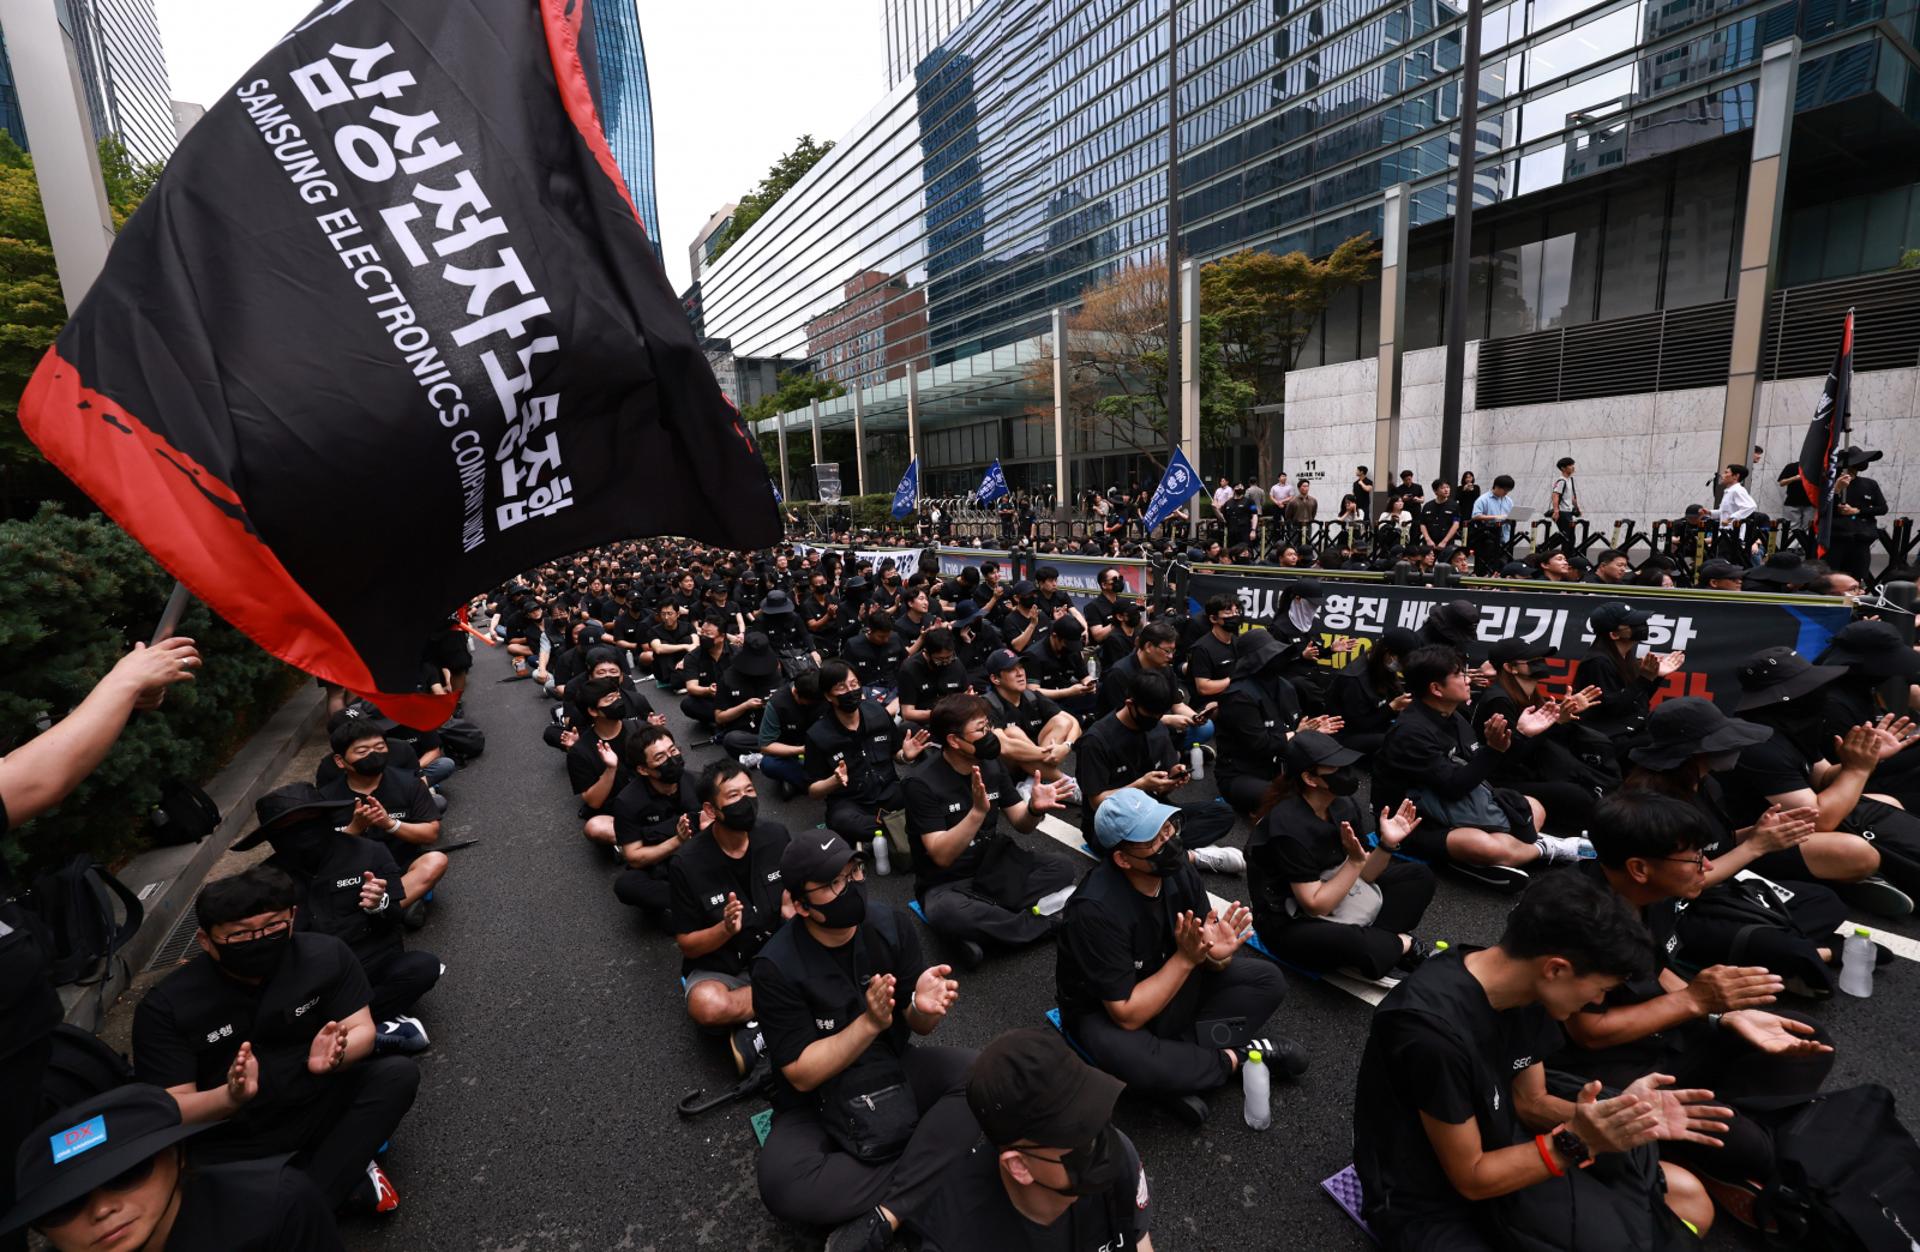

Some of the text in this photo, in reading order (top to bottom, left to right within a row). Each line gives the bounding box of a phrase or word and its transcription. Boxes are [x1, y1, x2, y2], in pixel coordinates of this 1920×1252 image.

[236, 77, 339, 205] SAMSUNG
[316, 208, 469, 428] ELECTRONICS
[1305, 460, 1316, 471] 11
[1311, 594, 1389, 634] 영진
[1397, 598, 1570, 651] 배리기
[336, 876, 362, 889] SECU
[207, 1023, 233, 1043] 동행
[64, 1124, 93, 1146] DX
